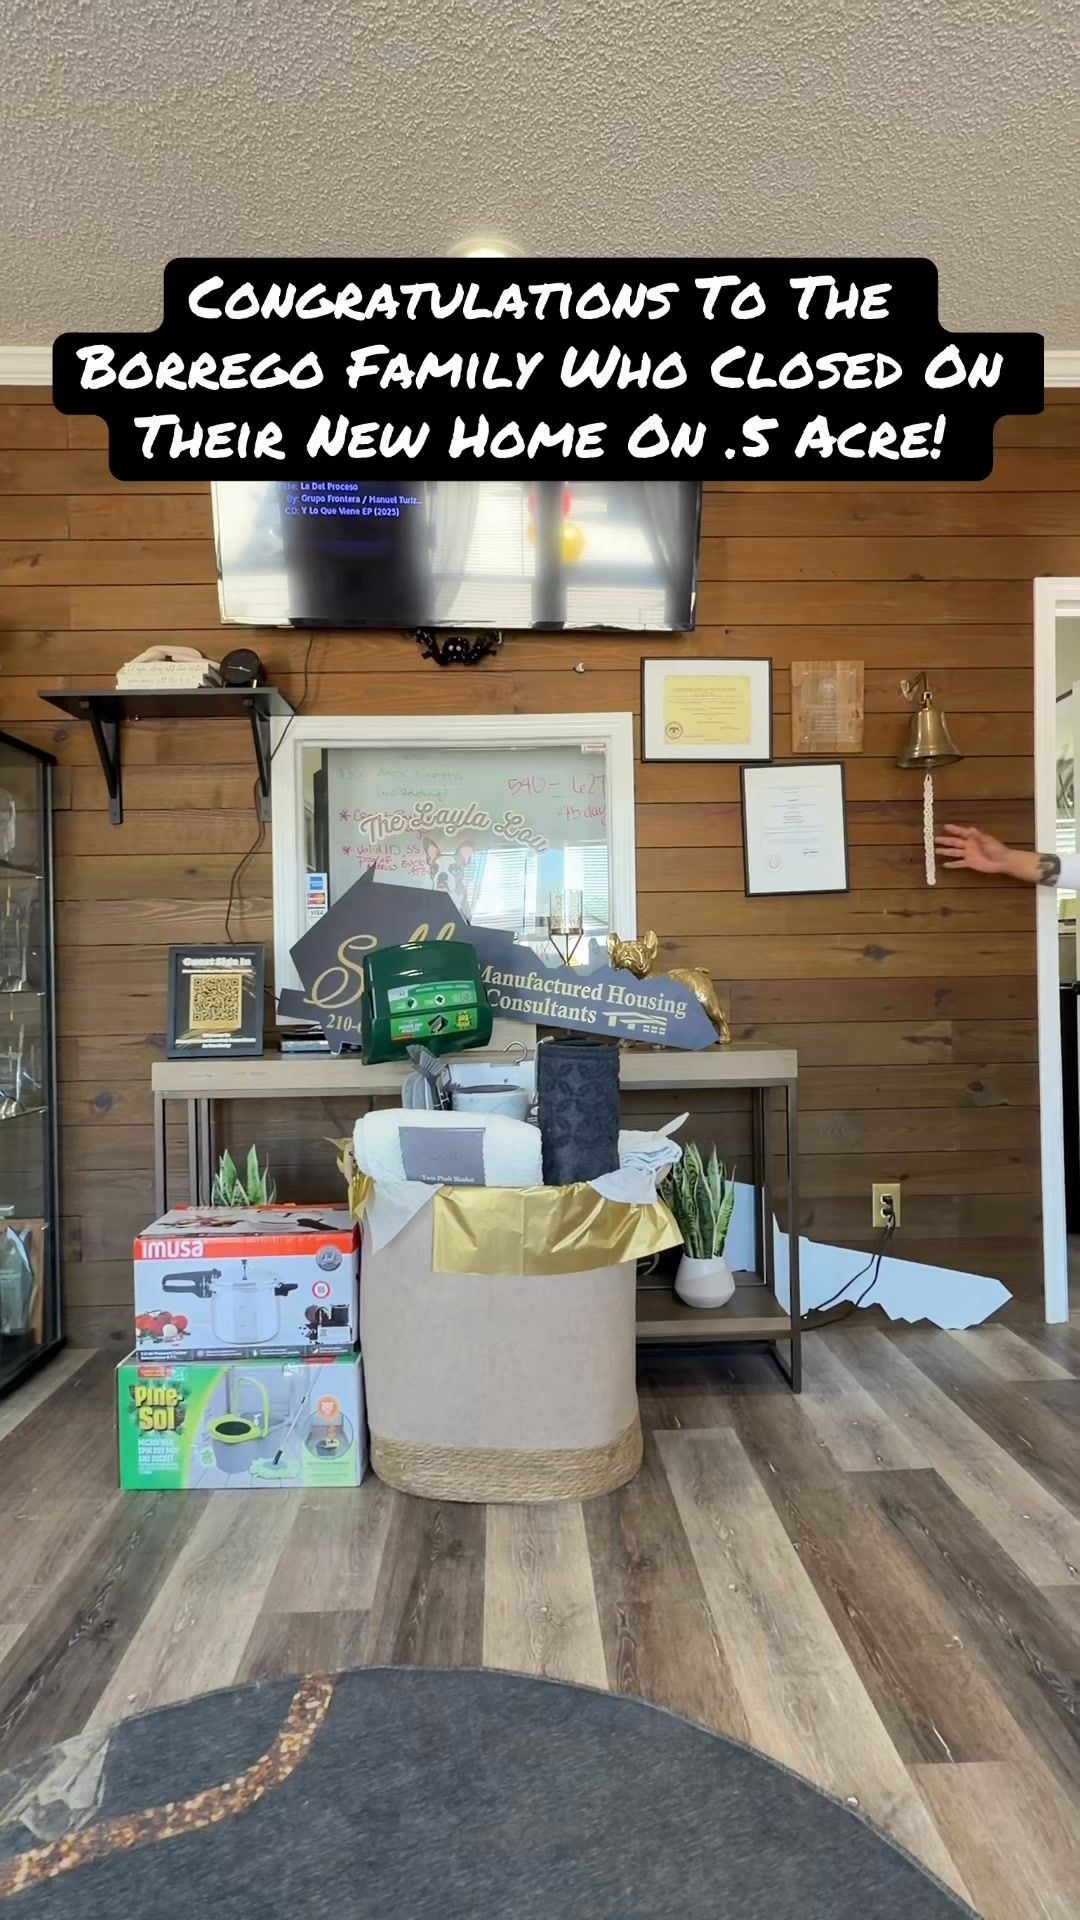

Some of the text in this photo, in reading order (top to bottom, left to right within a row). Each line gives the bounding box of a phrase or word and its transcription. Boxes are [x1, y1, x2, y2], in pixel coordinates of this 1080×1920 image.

[300, 482, 310, 491] La
[312, 482, 326, 491] Del
[327, 482, 358, 492] Proceso
[301, 494, 326, 505] Grupo
[327, 495, 361, 504] Frontera
[362, 495, 368, 505] /
[369, 495, 398, 505] Manuel
[284, 507, 400, 517] CD: Y Lo Que Viene EP (2025)
[360, 801, 550, 853] The Layla Lou
[478, 963, 602, 1001] Manufactured
[606, 984, 689, 1019] Housing
[486, 988, 597, 1024] Consultants
[138, 1406, 177, 1431] Sol
